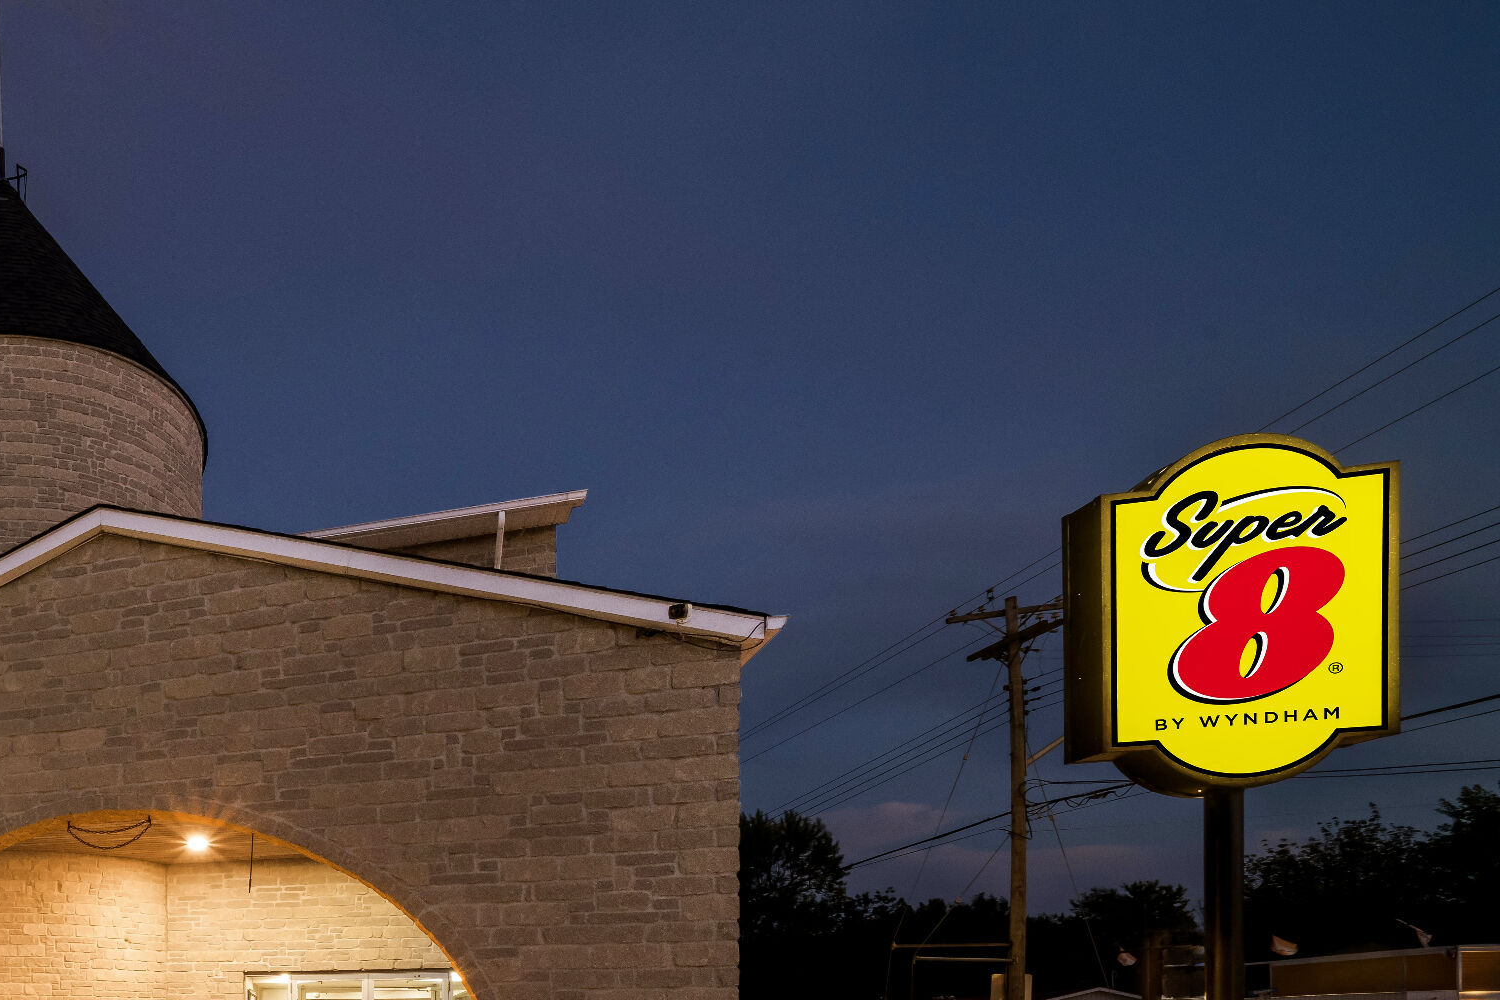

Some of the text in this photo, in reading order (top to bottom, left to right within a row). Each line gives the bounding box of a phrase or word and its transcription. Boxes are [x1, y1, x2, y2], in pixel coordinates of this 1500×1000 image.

[1141, 490, 1348, 584] Super
[1167, 546, 1346, 706] 8
[1155, 706, 1341, 731] BY WYNDHAM
